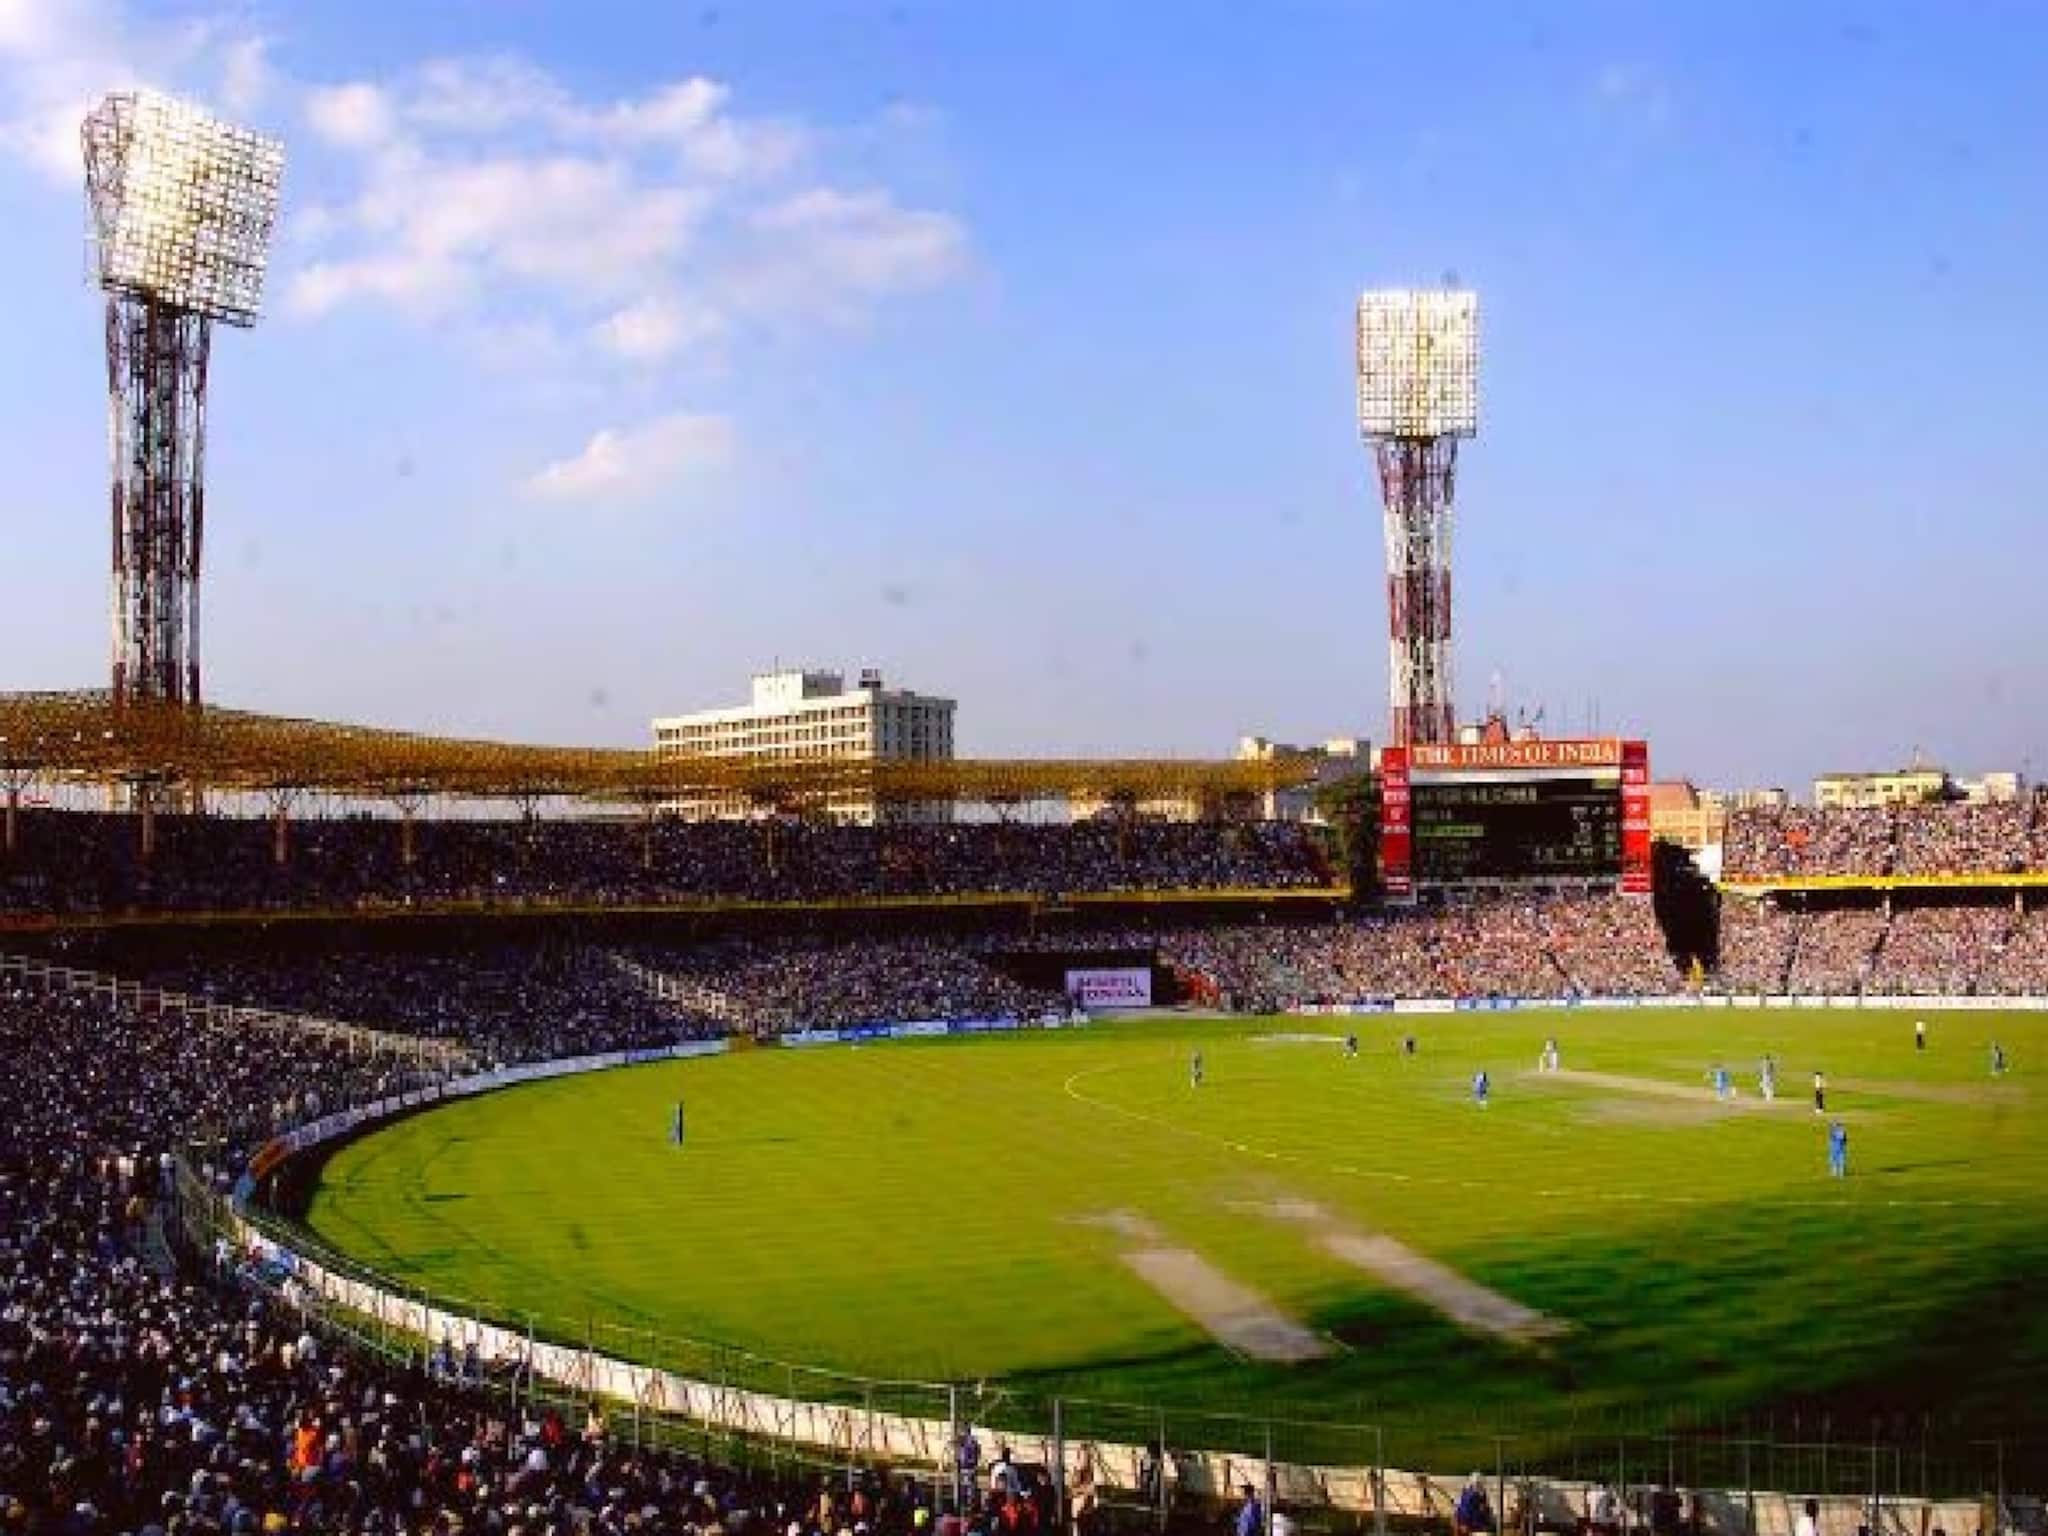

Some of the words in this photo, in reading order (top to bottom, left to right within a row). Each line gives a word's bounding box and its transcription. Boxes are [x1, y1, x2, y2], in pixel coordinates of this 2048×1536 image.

[1414, 747, 1456, 764] THE
[1462, 746, 1521, 763] TIMES
[1525, 746, 1550, 762] OF
[1559, 745, 1615, 761] INDIA
